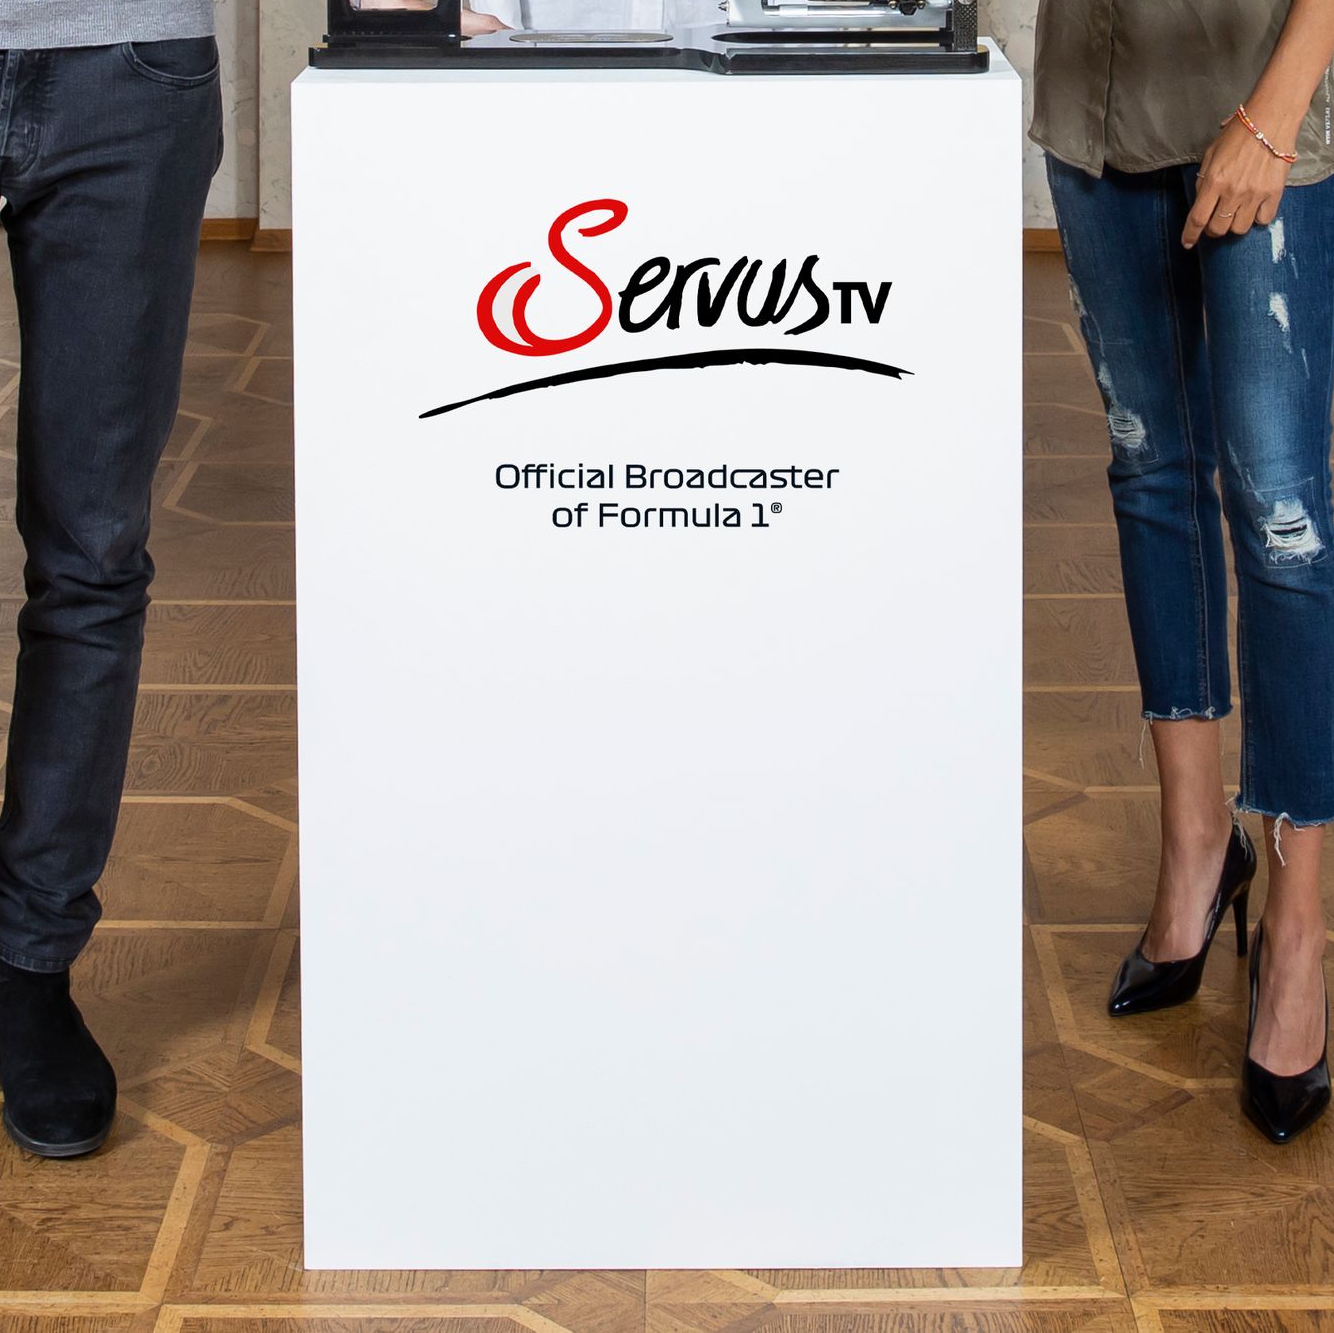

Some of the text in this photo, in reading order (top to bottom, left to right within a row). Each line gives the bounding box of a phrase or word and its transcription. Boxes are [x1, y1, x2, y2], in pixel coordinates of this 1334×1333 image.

[495, 463, 840, 490] Official Broadcaster
[552, 502, 589, 528] of
[599, 502, 741, 528] Formula
